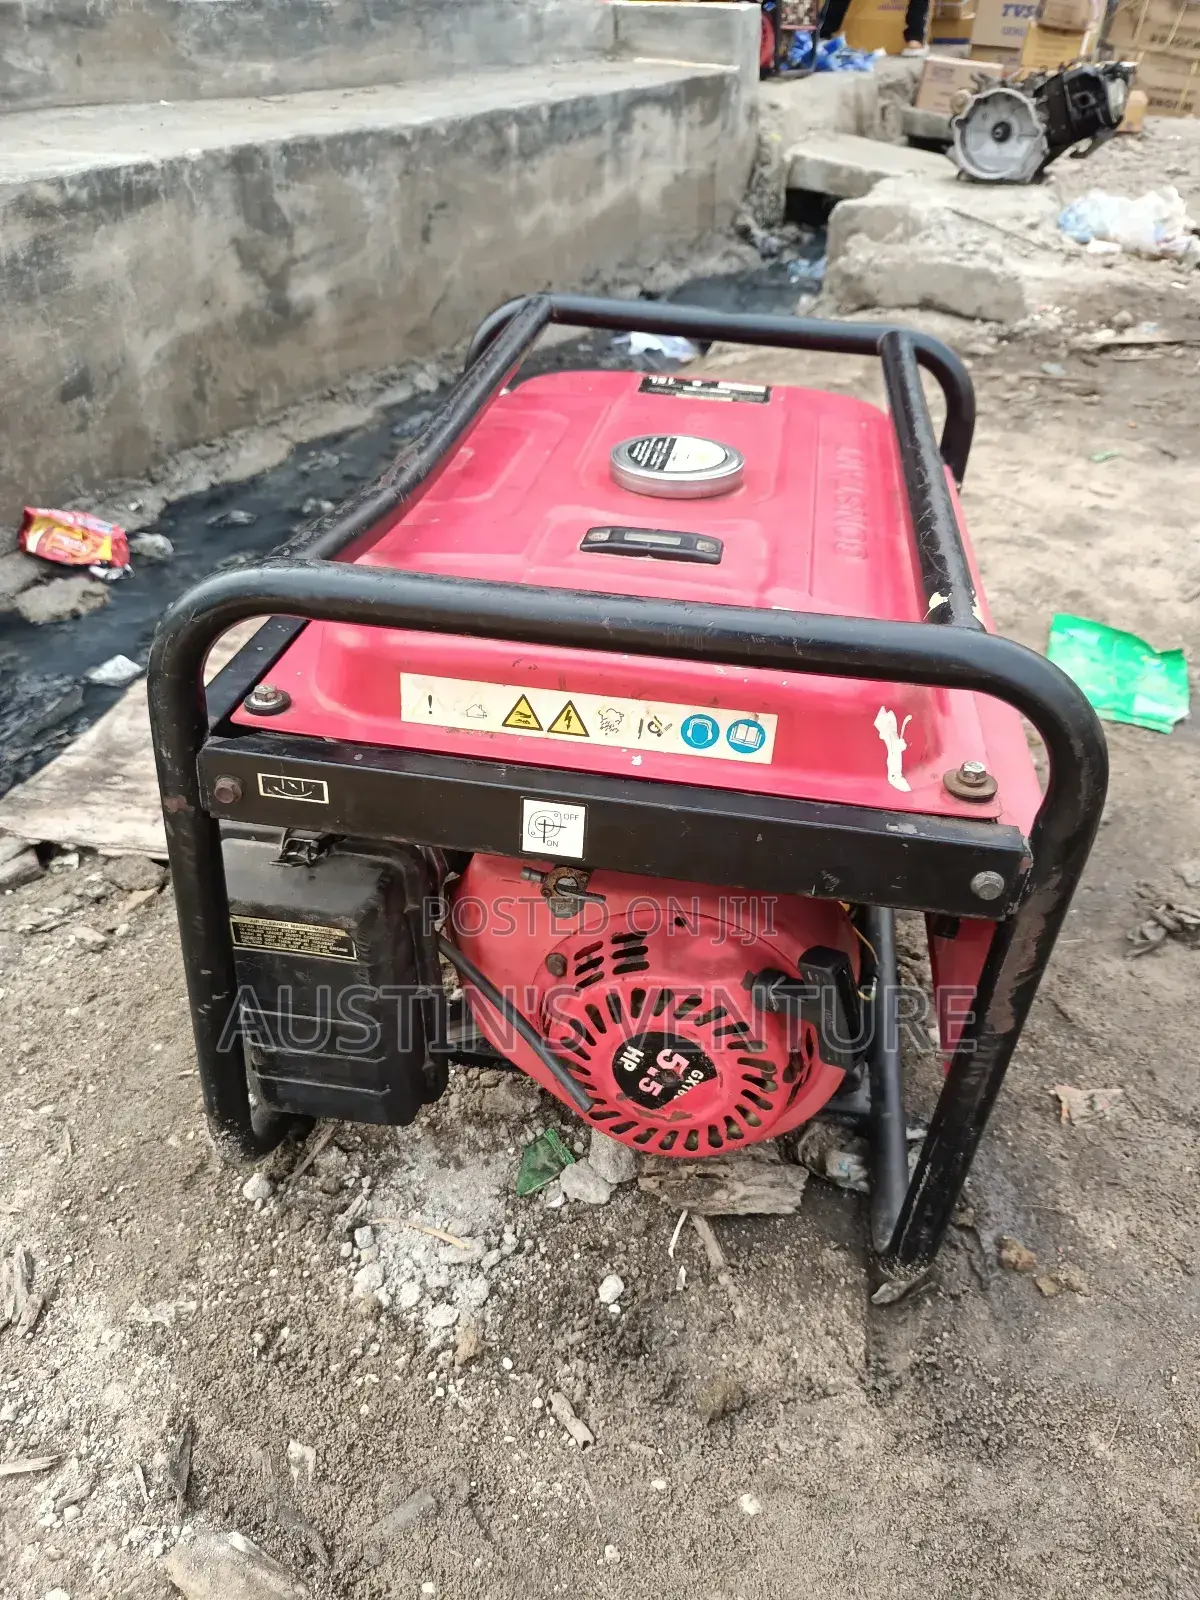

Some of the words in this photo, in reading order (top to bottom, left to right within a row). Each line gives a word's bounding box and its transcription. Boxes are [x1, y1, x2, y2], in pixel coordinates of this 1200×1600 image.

[563, 813, 580, 821] OFF
[546, 839, 559, 847] ON
[619, 1045, 645, 1072] HP
[638, 1048, 690, 1097] 5.5
